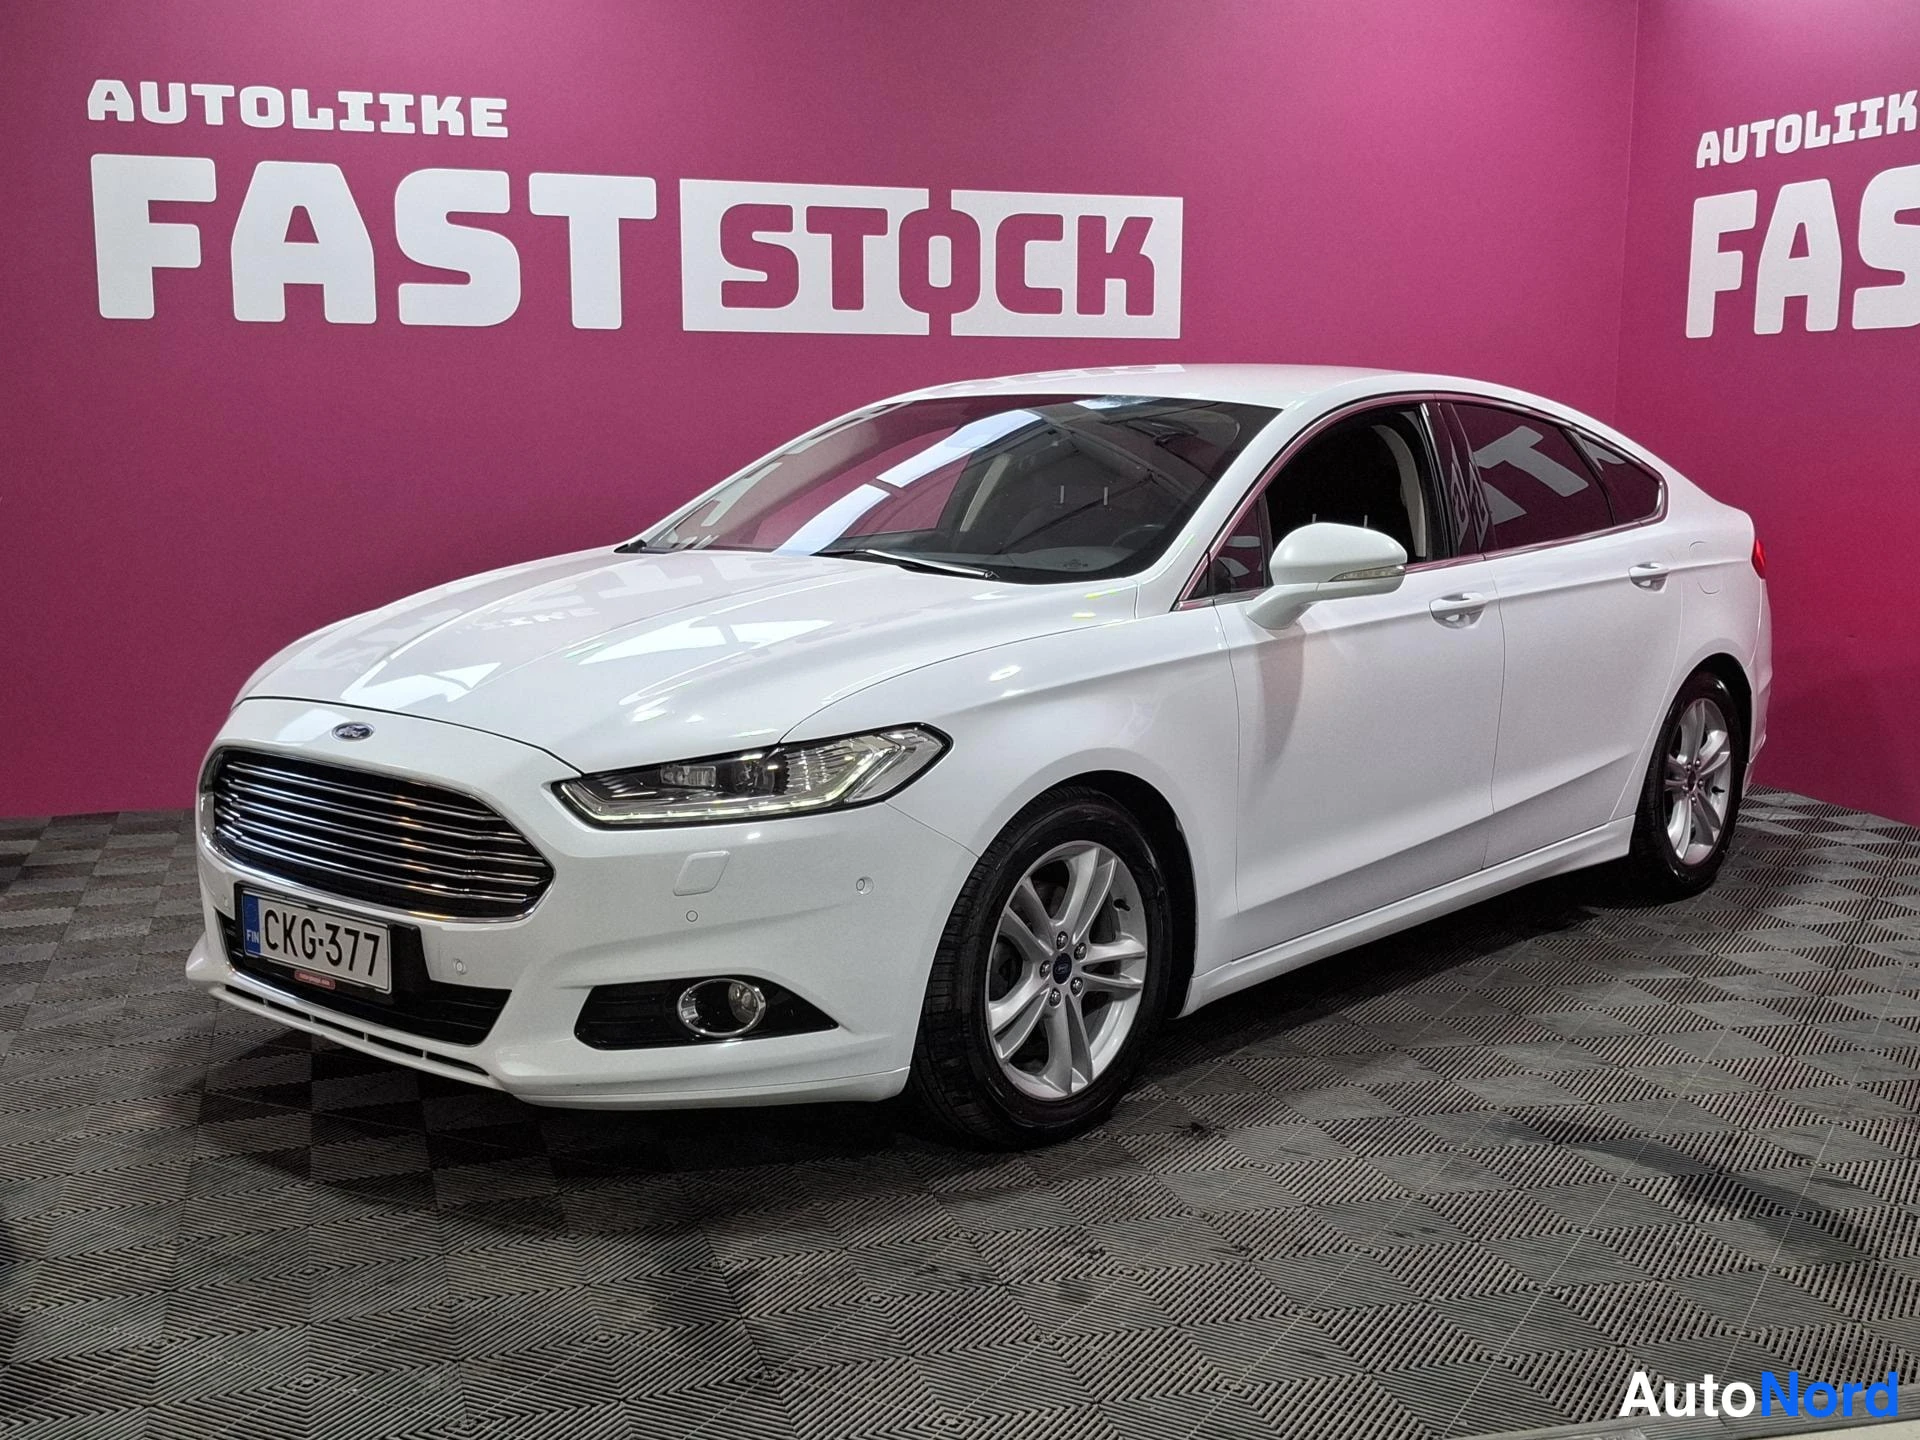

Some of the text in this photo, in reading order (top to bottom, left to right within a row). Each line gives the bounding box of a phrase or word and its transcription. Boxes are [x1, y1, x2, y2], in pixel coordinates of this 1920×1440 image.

[87, 79, 509, 138] AUTOLIIKE
[90, 153, 1156, 330] FAST STOCK
[246, 909, 381, 977] FIN CKG-377
